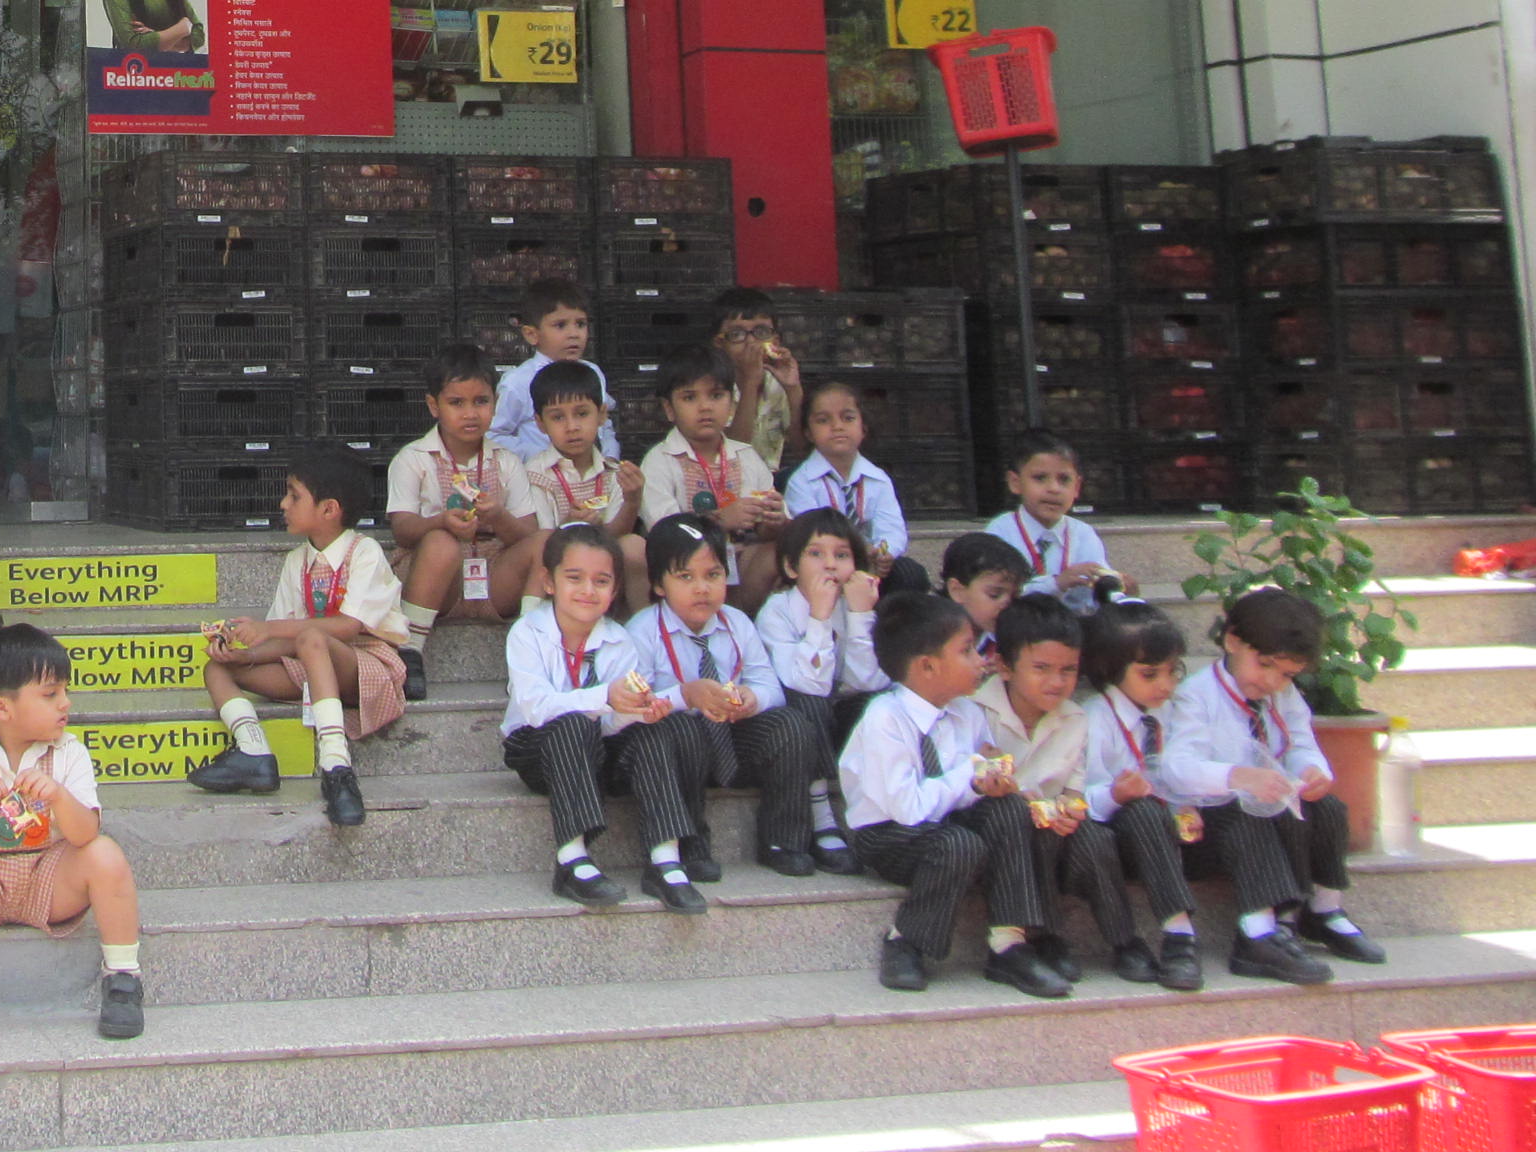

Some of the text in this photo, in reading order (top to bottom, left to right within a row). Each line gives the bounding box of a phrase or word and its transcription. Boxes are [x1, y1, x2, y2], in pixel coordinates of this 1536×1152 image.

[8, 561, 158, 584] Everything
[10, 587, 89, 605] Below
[66, 640, 194, 665] erything
[68, 668, 121, 687] low
[84, 727, 233, 754] Everythin
